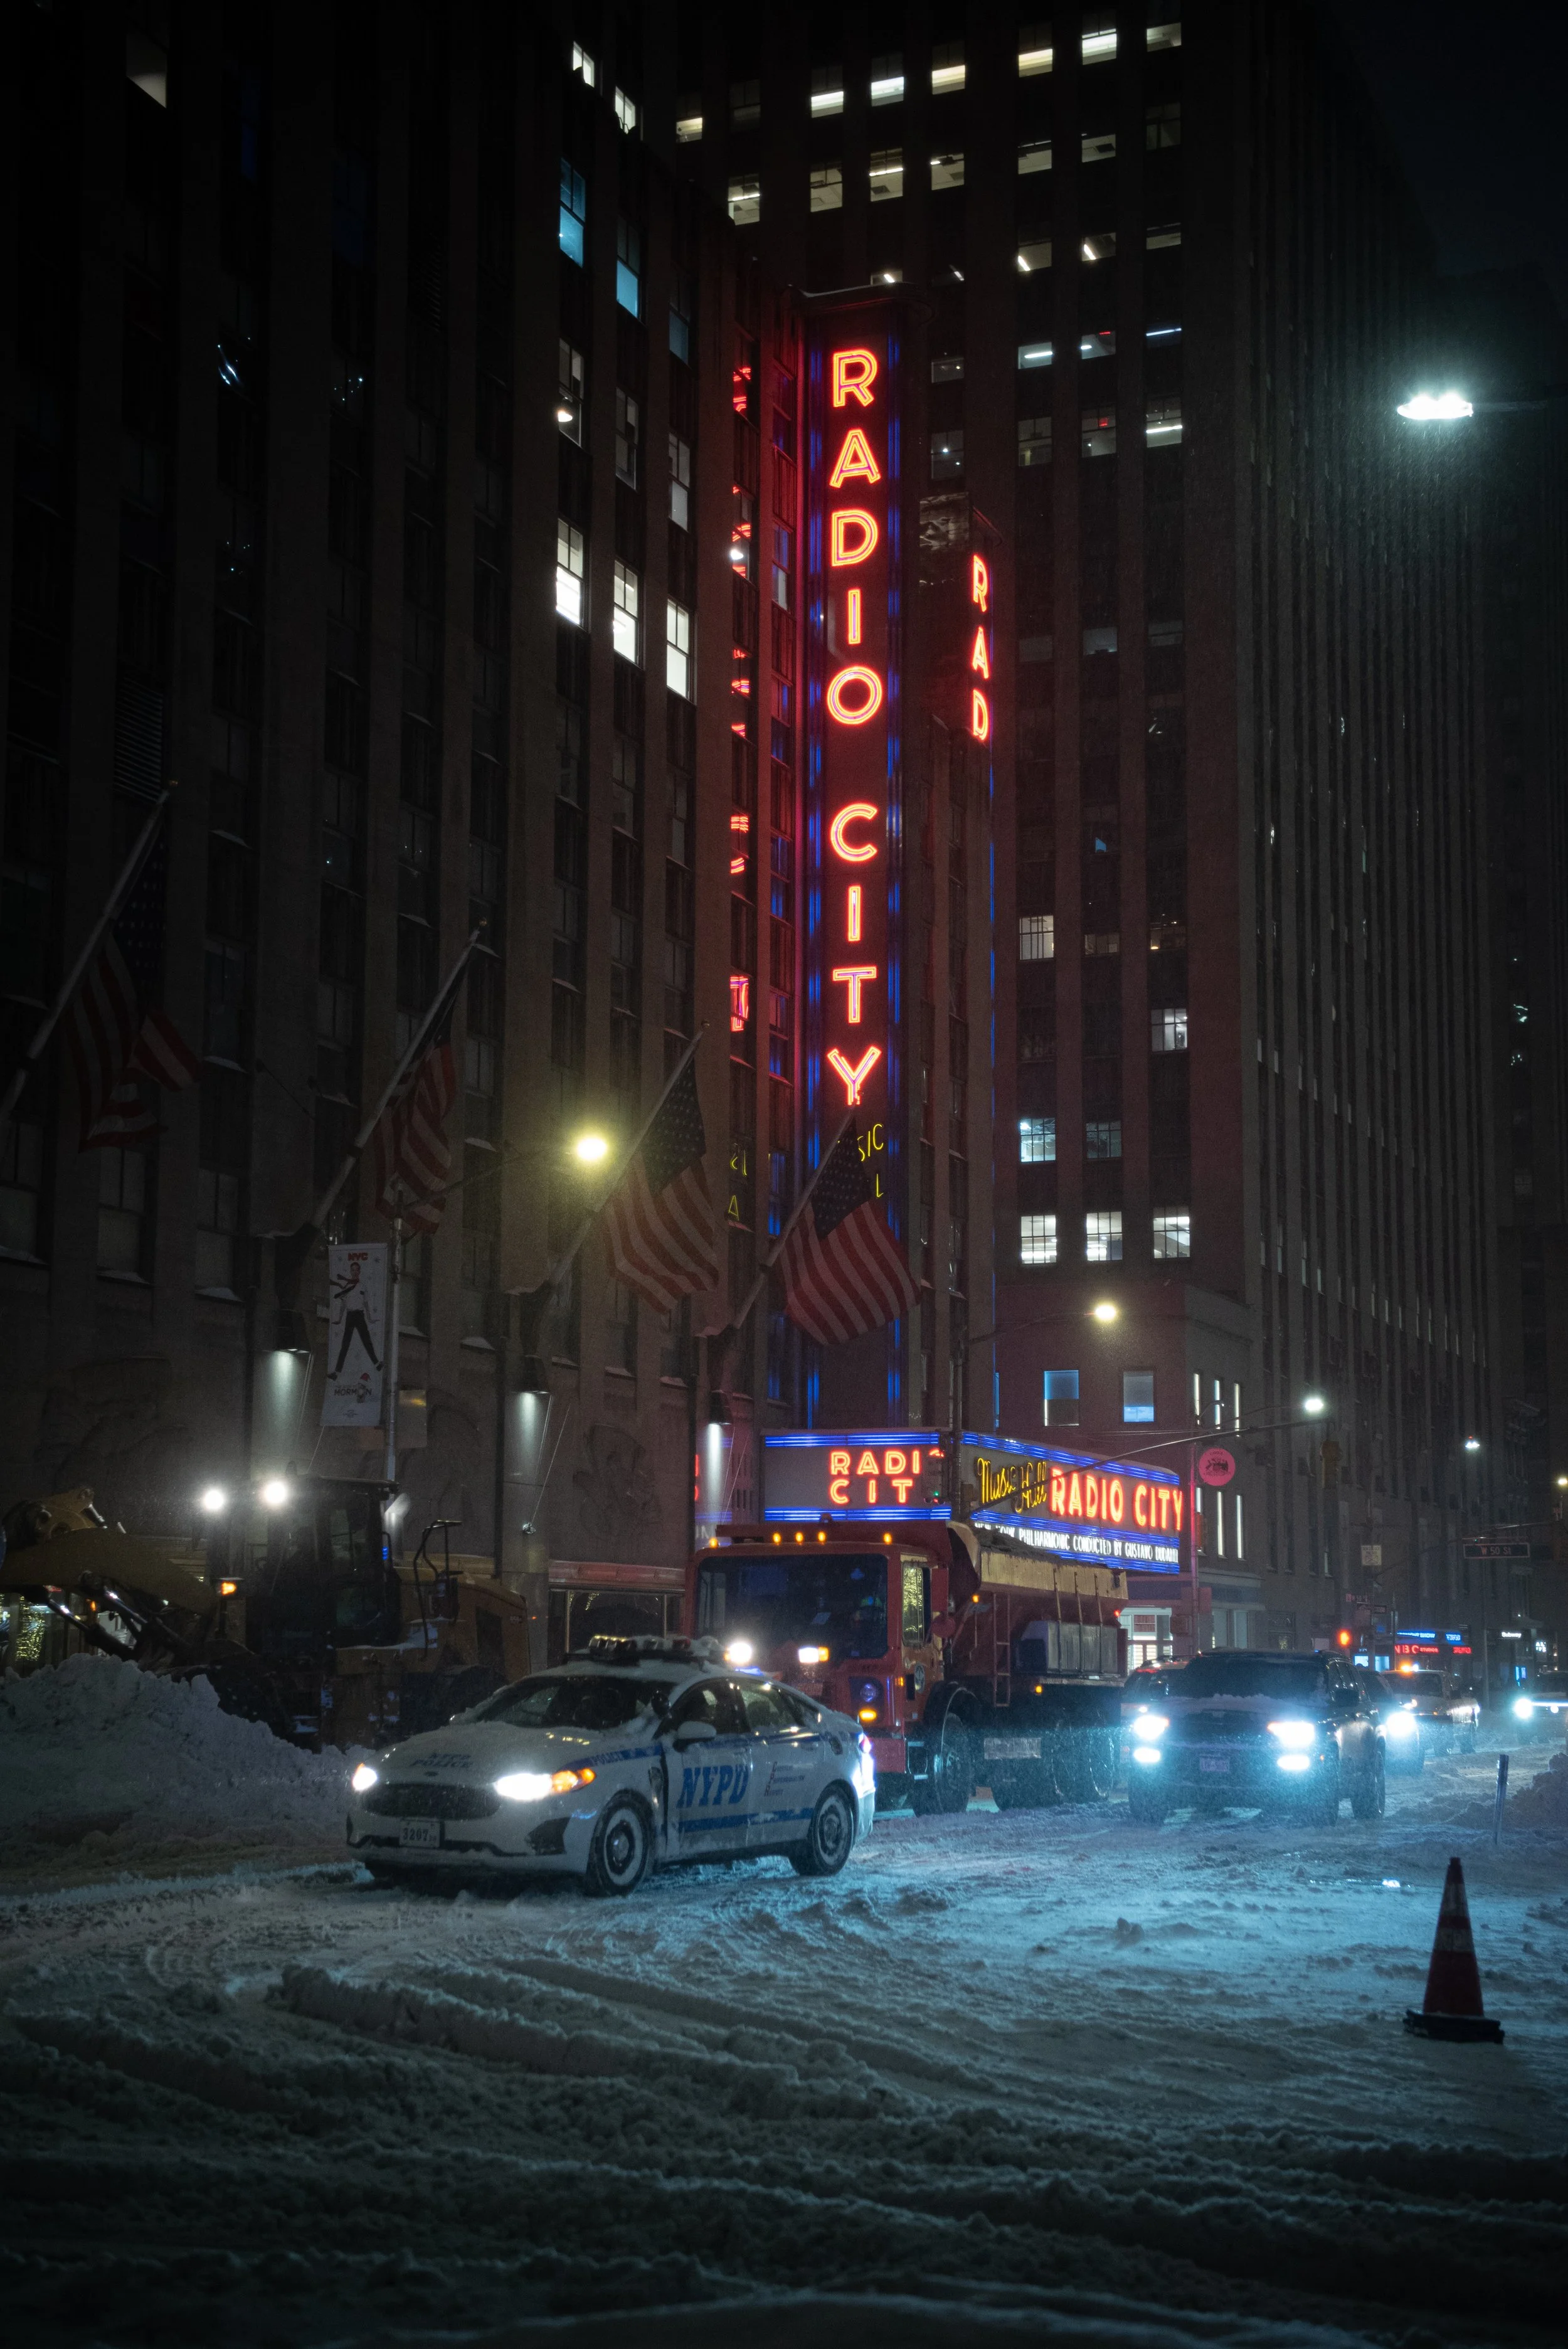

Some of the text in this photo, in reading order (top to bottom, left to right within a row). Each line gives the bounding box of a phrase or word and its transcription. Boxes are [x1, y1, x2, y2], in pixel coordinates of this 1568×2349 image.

[972, 553, 991, 742] RAD
[827, 348, 883, 1106] RADIO CITY
[347, 1252, 369, 1261] NYC
[830, 1448, 945, 1475] RADI
[1049, 1465, 1124, 1524] RADIO
[1133, 1483, 1184, 1531] CITY
[1019, 1527, 1071, 1551] PHILHARMONIC
[1073, 1535, 1112, 1556] CONDUCTED
[1113, 1539, 1123, 1557] BY
[1125, 1542, 1153, 1561] GUSTAVO
[1481, 1546, 1488, 1556] W
[1490, 1546, 1500, 1556] 50
[676, 1764, 750, 1808] NYPD
[403, 1827, 430, 1842] 3207
